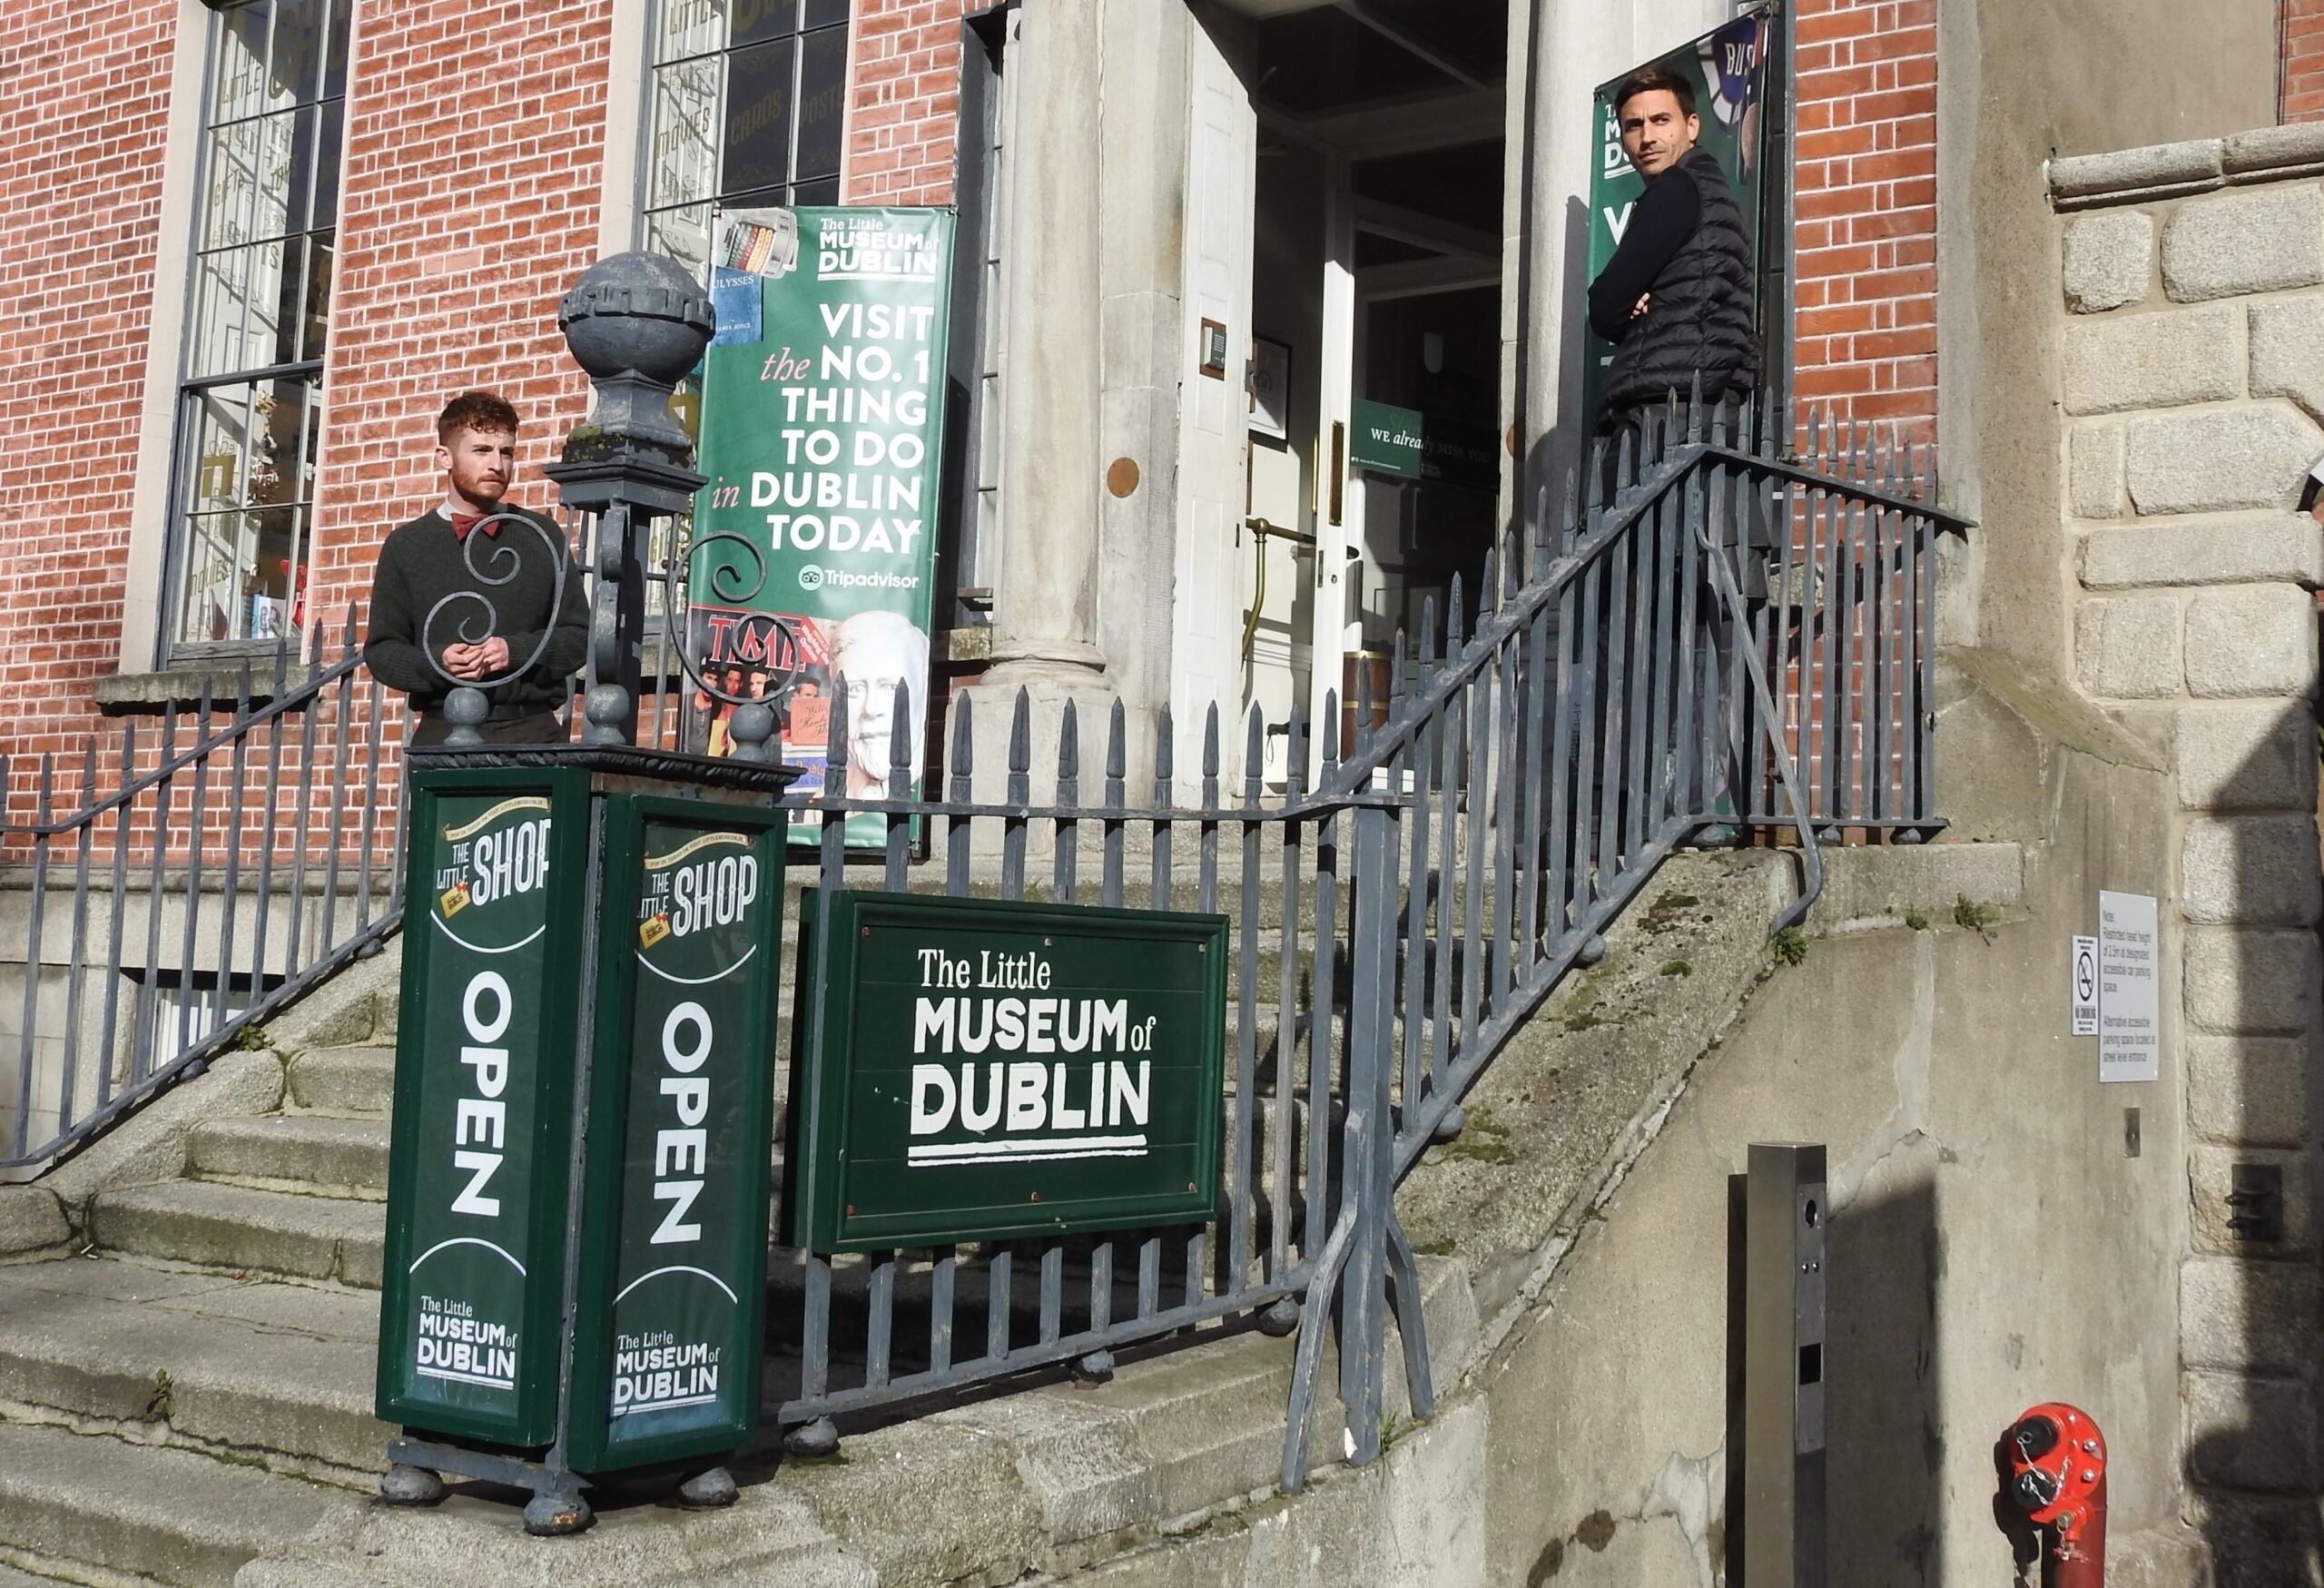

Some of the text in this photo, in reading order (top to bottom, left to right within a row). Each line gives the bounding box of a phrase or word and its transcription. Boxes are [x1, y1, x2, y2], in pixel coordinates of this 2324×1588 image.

[819, 231, 940, 252] MUSEUM of
[820, 217, 883, 232] The Little
[817, 251, 938, 273] DUBLIN
[819, 303, 935, 340] VISIT
[759, 346, 811, 382] the
[781, 388, 928, 426] THING
[781, 429, 925, 469] TO DO
[1371, 428, 1391, 443] WE
[712, 471, 921, 512] in DUBLIN
[766, 514, 922, 554] TODAY
[824, 569, 920, 589] Tripadvisor
[452, 841, 471, 865] THE
[436, 864, 469, 890] LITTLE
[636, 895, 669, 919] ITTLE
[652, 854, 758, 938] THE SHOP
[918, 948, 1052, 990] The Little
[913, 997, 1157, 1053] MUSEUM of
[451, 971, 513, 1217] OPEN
[910, 1060, 1151, 1135] DUBLIN
[650, 1001, 713, 1244] OPEN
[420, 1295, 473, 1317] The Little
[419, 1312, 518, 1349] MUSEUM of
[617, 1329, 674, 1350] The Little
[417, 1336, 516, 1379] DUBLIN
[615, 1342, 721, 1376] MUSEUM of
[614, 1365, 718, 1406] DUBLIN
